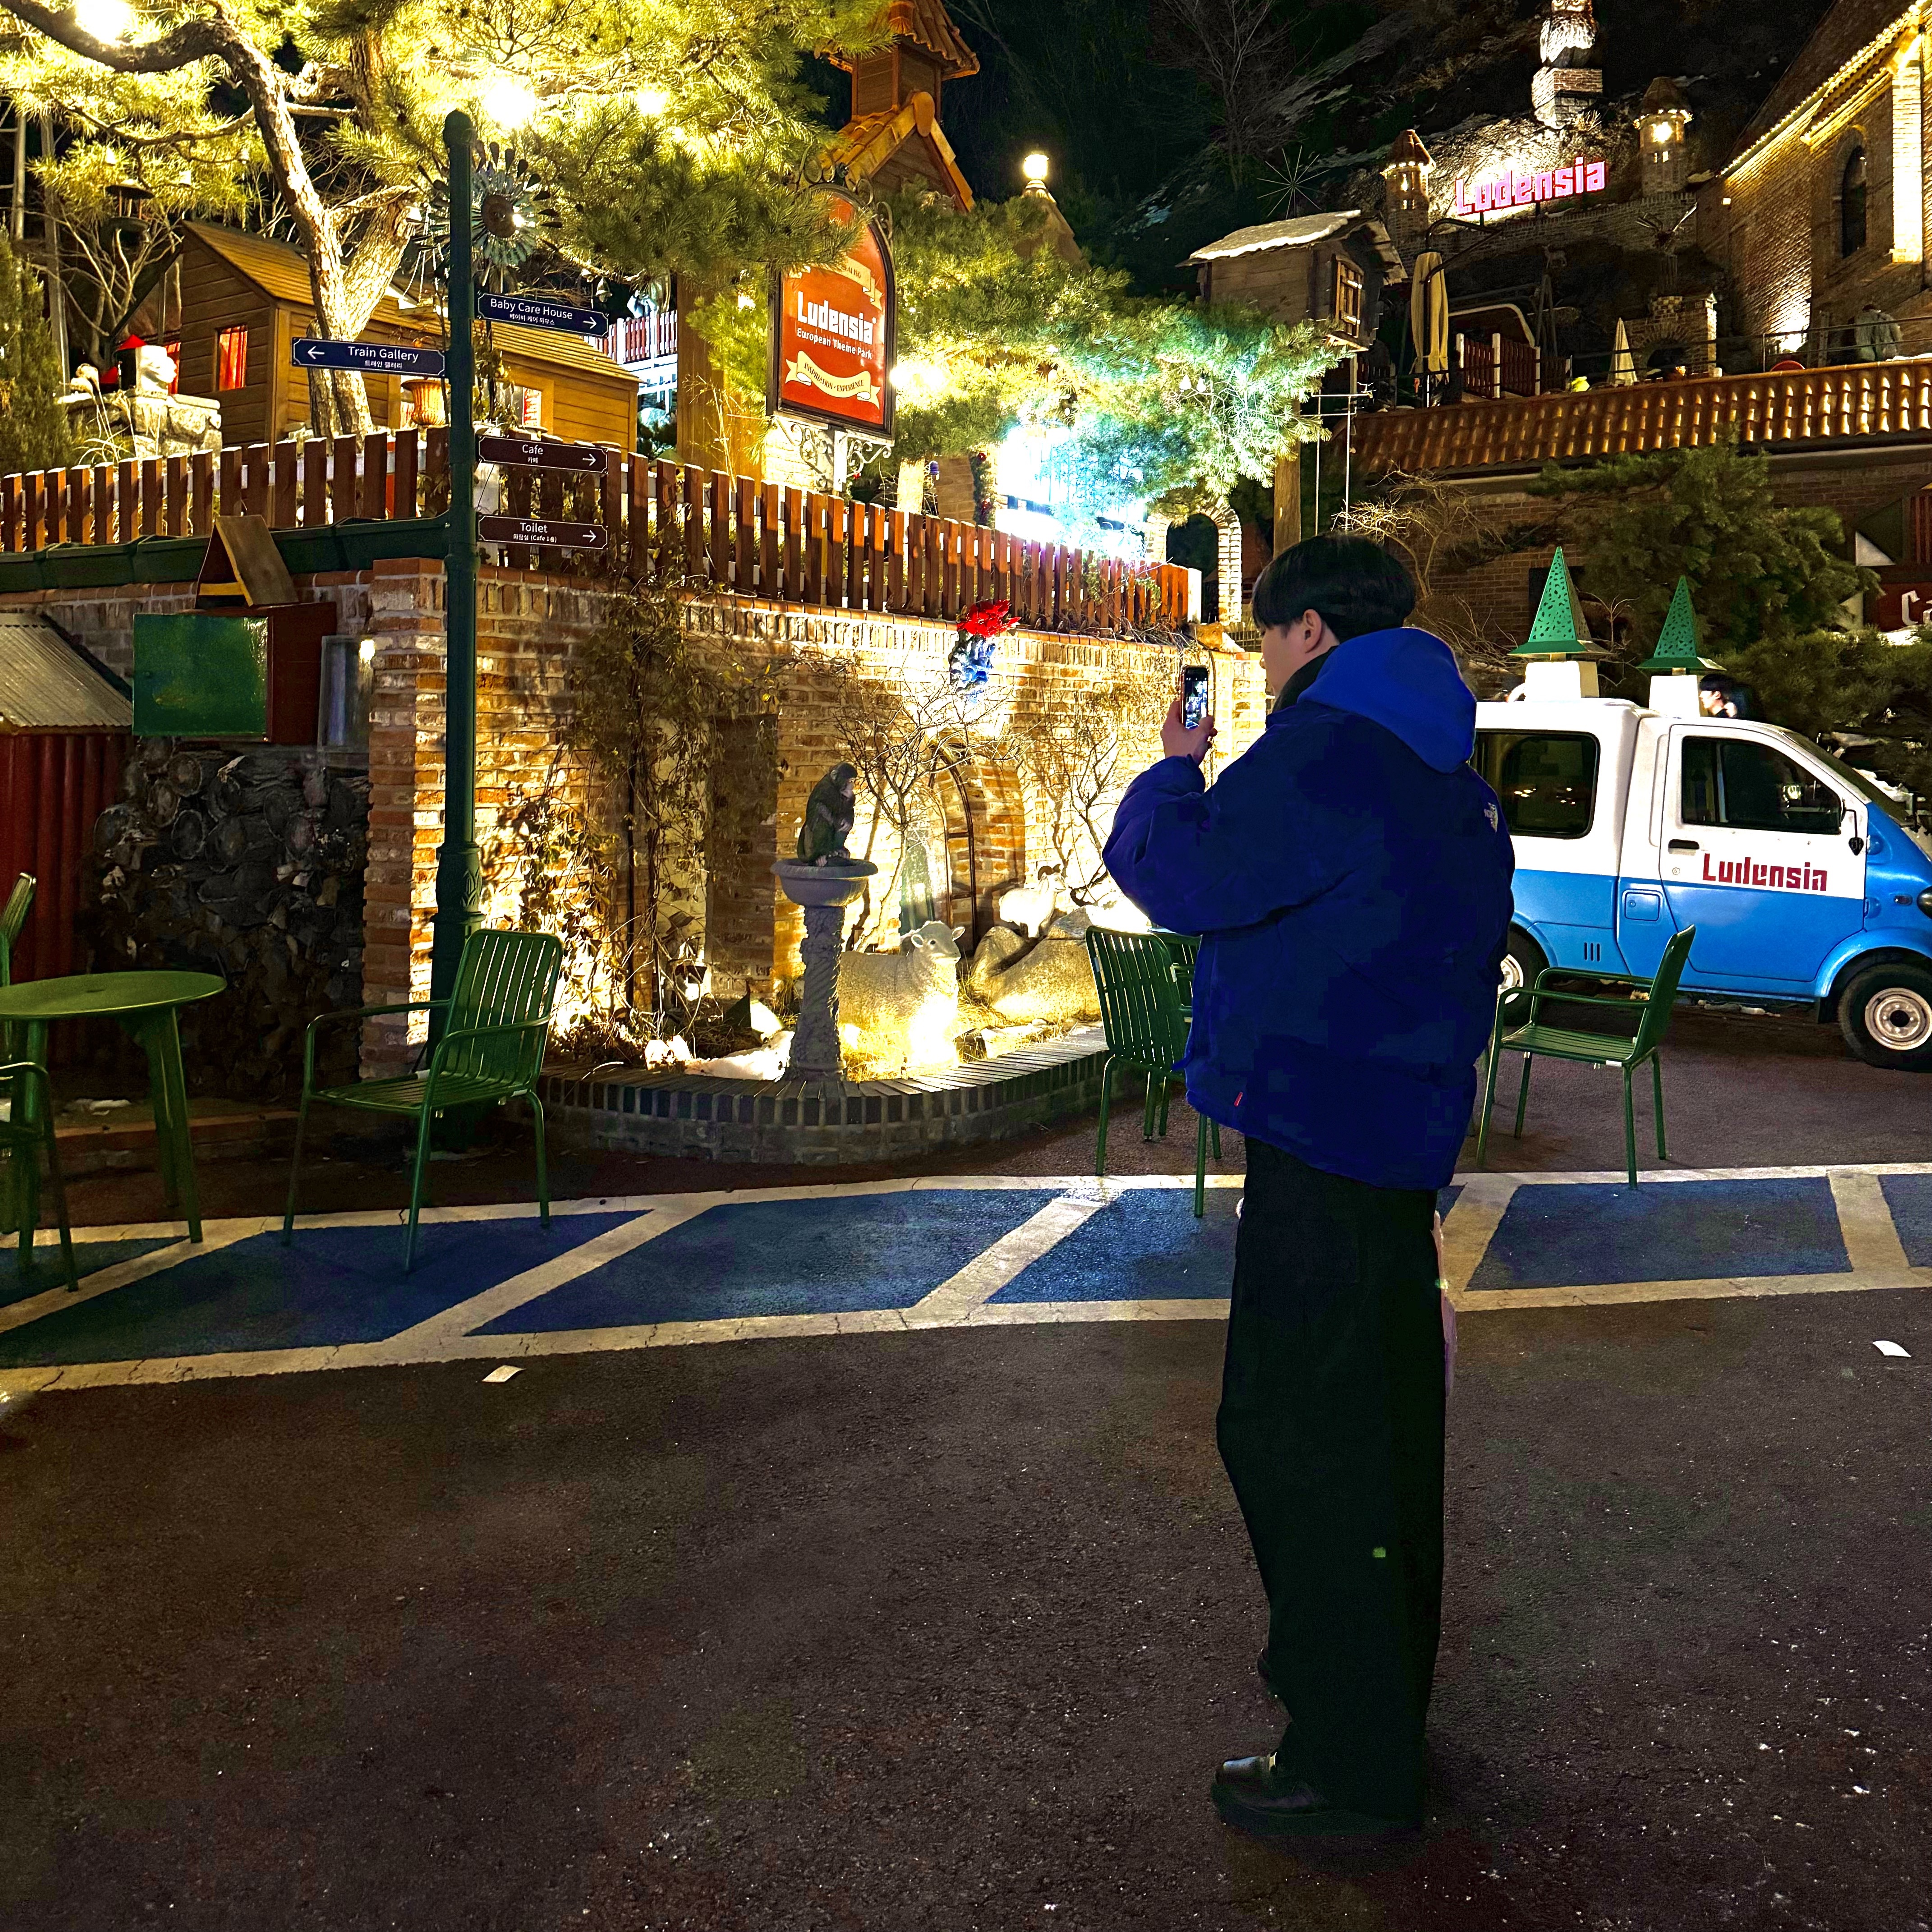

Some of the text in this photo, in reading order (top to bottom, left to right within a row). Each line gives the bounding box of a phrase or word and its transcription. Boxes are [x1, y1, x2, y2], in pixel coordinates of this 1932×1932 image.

[1455, 156, 1605, 216] Ludensia
[491, 298, 573, 319] Baby Care House
[509, 313, 525, 321] 베이비
[797, 291, 873, 345] Ludensia
[348, 346, 419, 363] Train Gallery
[797, 327, 872, 360] European Theme Park
[804, 362, 864, 392] INSPIRATION EXPERIENCE
[522, 444, 543, 455] Cafe
[520, 522, 547, 533] Toilet
[1702, 853, 1827, 891] Ludensia
